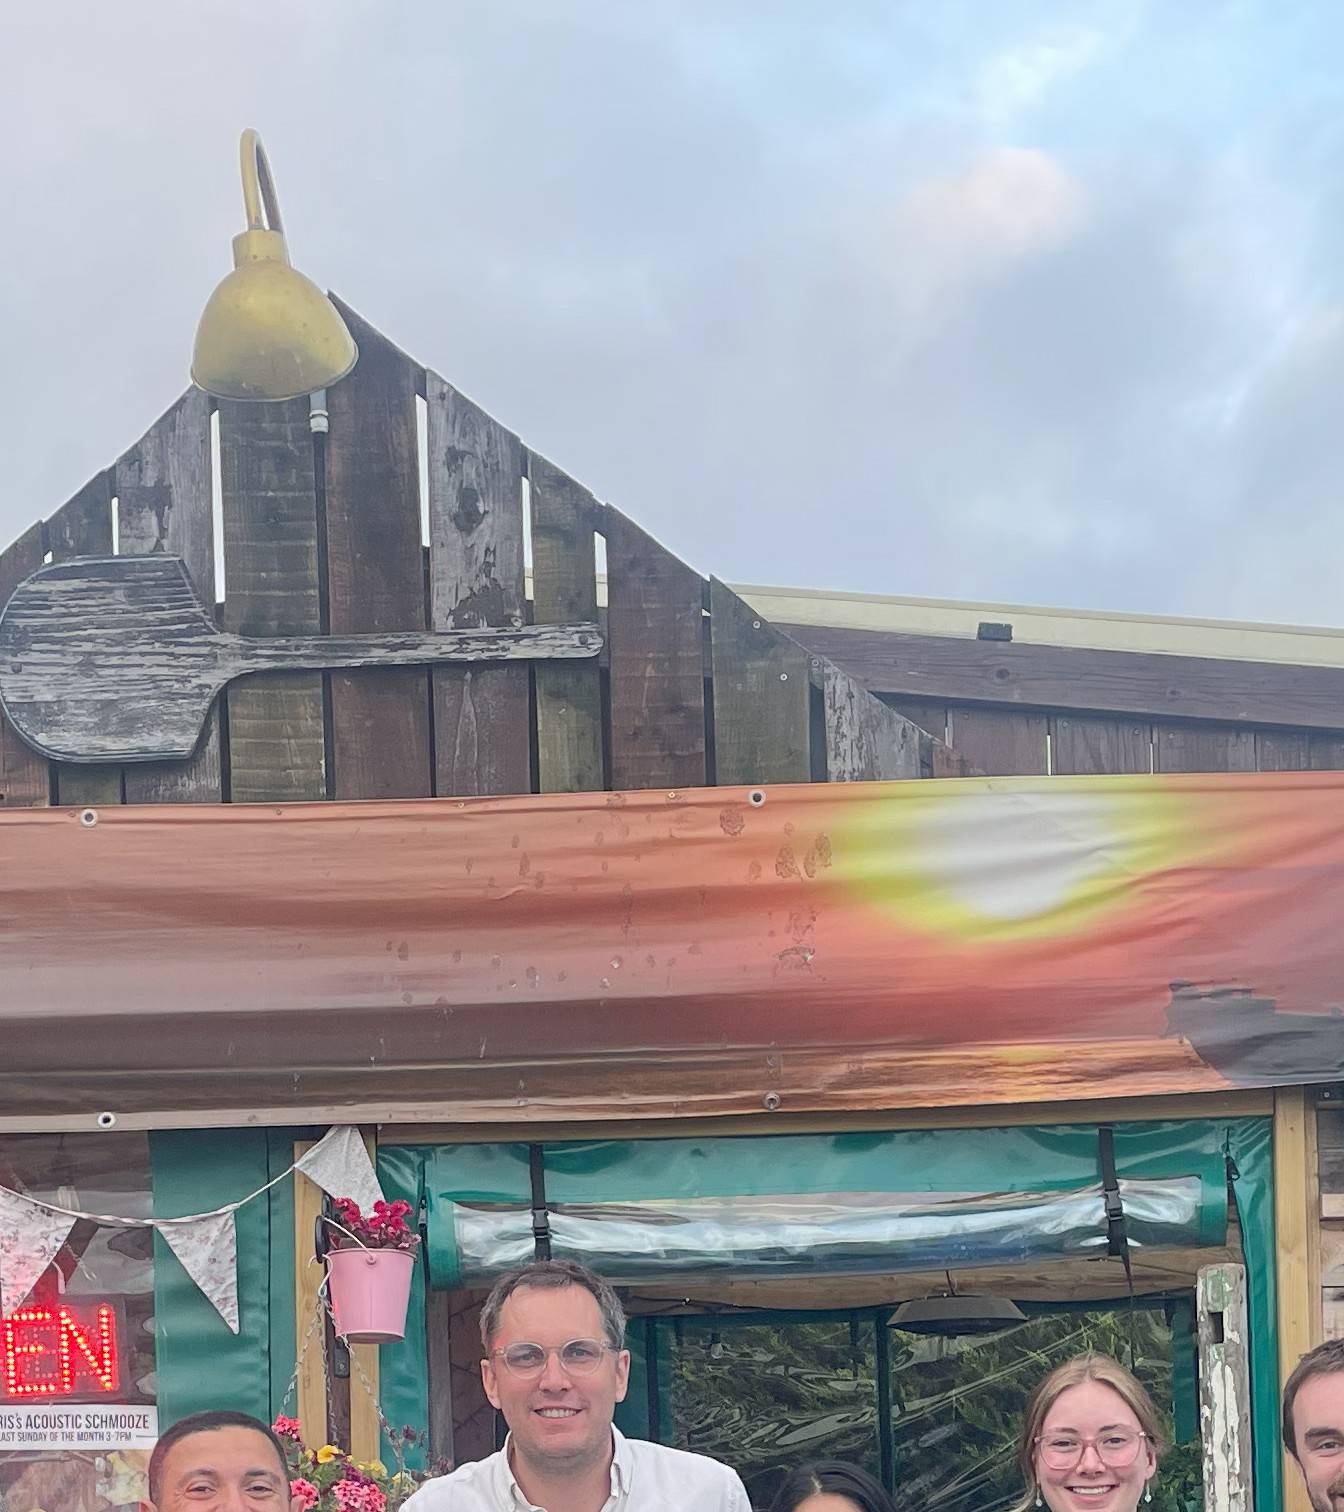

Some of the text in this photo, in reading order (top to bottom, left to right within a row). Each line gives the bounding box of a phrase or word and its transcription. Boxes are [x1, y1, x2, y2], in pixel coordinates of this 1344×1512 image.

[25, 1413, 83, 1430] ACOUSTIC
[84, 1413, 150, 1430] SCHMOOZE
[17, 1431, 48, 1442] SUNDAY
[49, 1431, 59, 1442] OF
[61, 1431, 75, 1442] THE
[76, 1431, 105, 1442] MONTH
